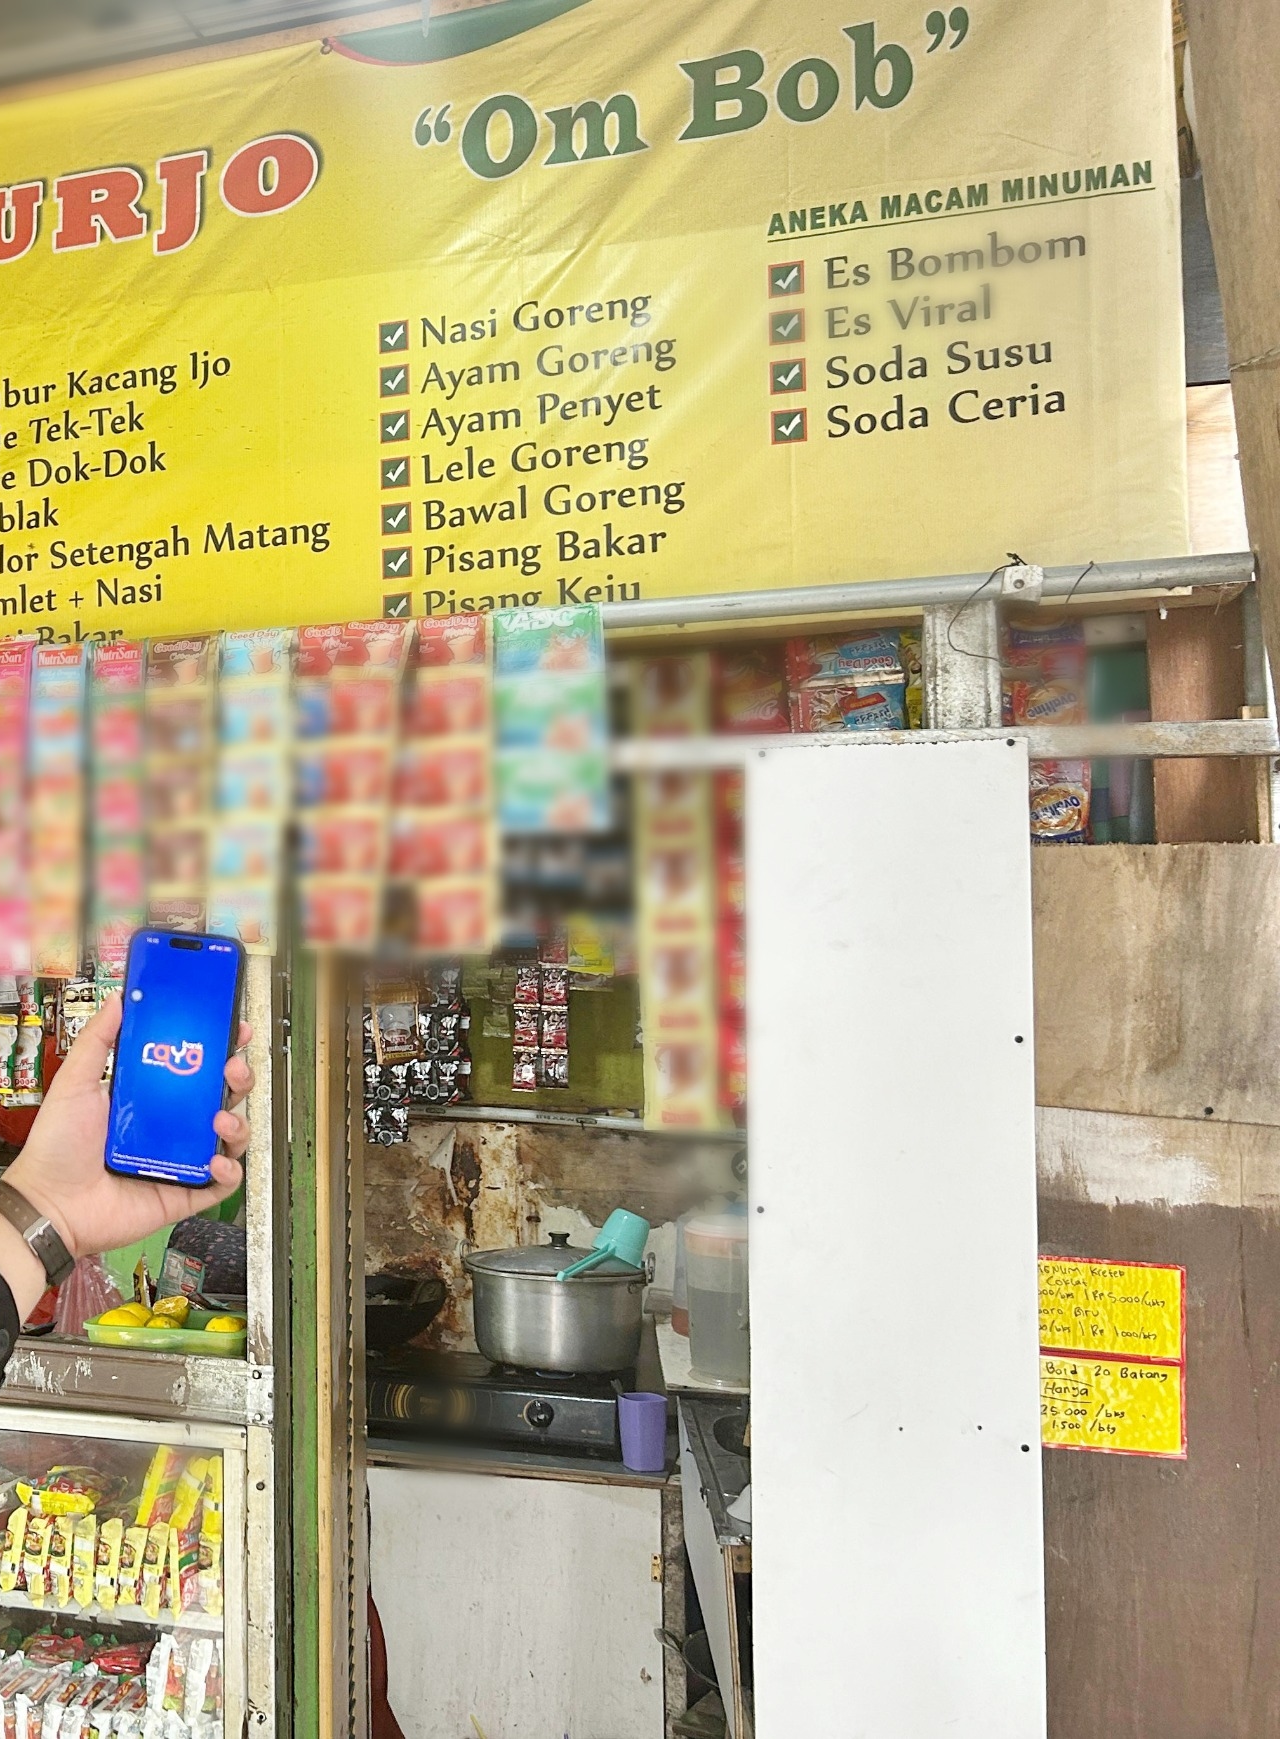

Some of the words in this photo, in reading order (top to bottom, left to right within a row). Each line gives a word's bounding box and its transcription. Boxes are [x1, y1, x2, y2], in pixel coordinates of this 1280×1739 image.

[413, 94, 649, 179] “Om
[677, 6, 970, 142] Bob”
[767, 201, 868, 236] ANEKA
[880, 183, 989, 219] MACAM
[1002, 160, 1153, 203] MINUMAN
[825, 255, 871, 290] Es
[888, 231, 1087, 281] Bombom
[420, 308, 497, 348] Nasi
[513, 294, 652, 332] Goreng
[825, 305, 871, 339] Es
[887, 283, 992, 331] Viral
[67, 364, 178, 398] Kacang
[190, 350, 231, 389] Ijo
[420, 359, 520, 400] Ayam
[536, 338, 677, 377] Goreng
[826, 344, 928, 389] Soda
[946, 340, 1052, 375] Susu
[29, 400, 145, 444] Tek-Tek
[420, 406, 521, 446] Ayam
[536, 384, 662, 426] Penyet
[827, 394, 929, 438] Soda
[948, 383, 1066, 425] Ceria
[27, 440, 167, 487] Dok-Dok
[421, 446, 496, 484] Lele
[511, 437, 649, 472] Goreng
[422, 484, 527, 530] Bawal
[544, 481, 686, 515] Goreng
[50, 525, 190, 570] Setengah
[203, 520, 331, 553] Matang
[423, 544, 542, 576] Pisang
[556, 522, 667, 562] Bakar
[97, 574, 163, 607] Nasi
[39, 652, 78, 665] NutriSari
[1044, 1381, 1089, 1398] Hanya
